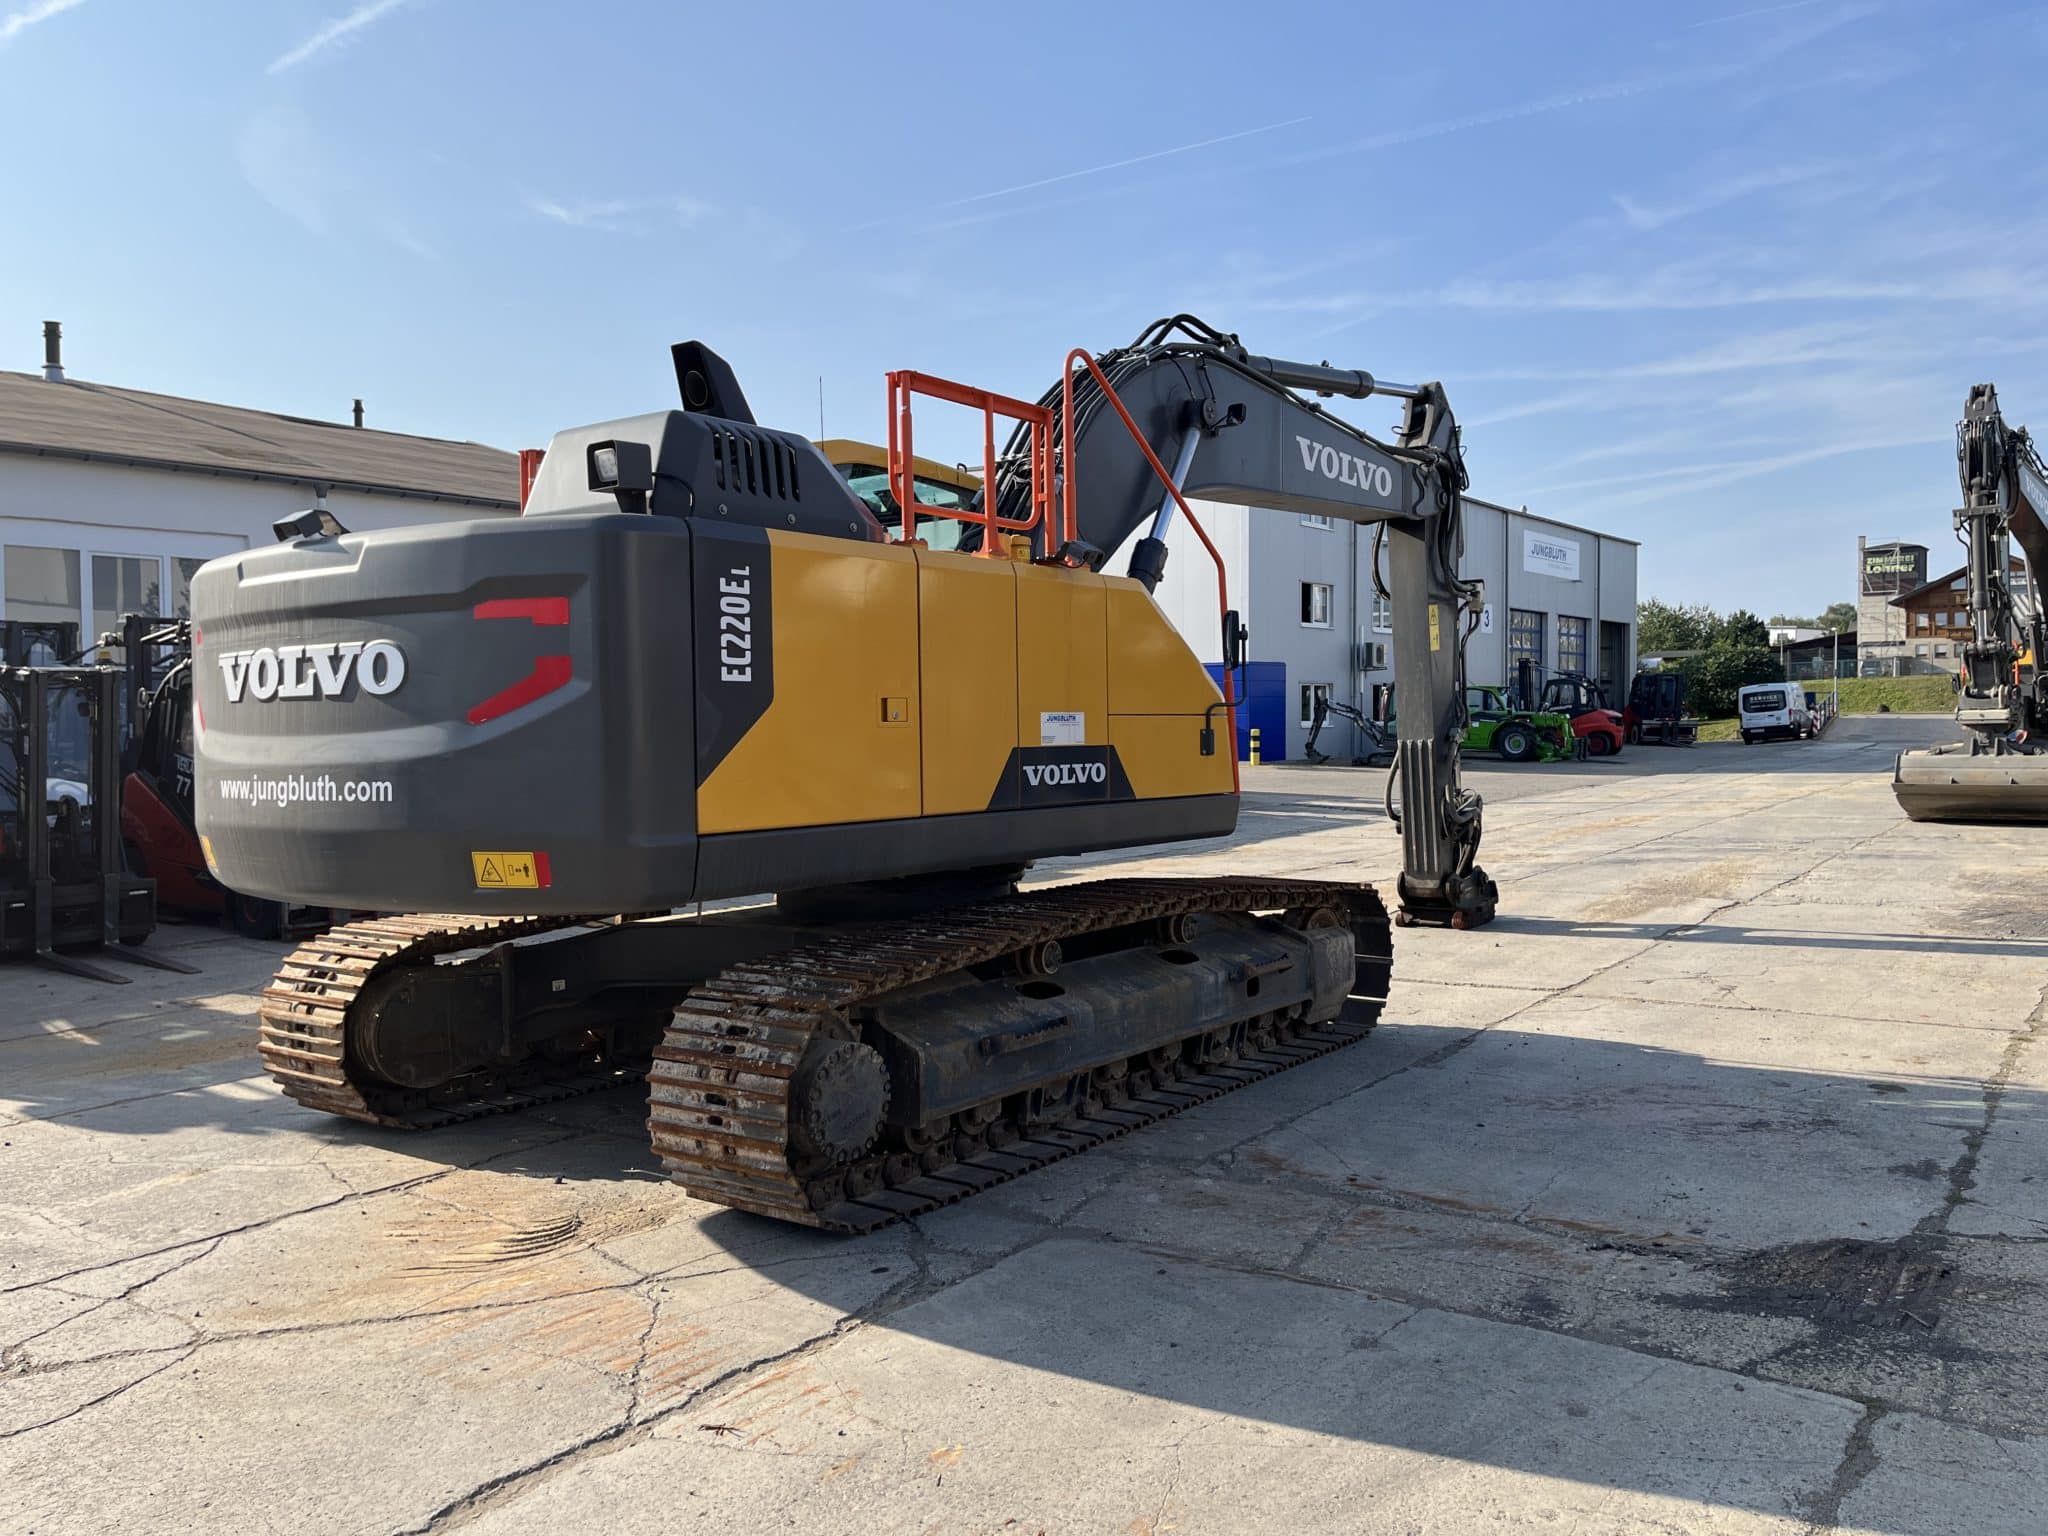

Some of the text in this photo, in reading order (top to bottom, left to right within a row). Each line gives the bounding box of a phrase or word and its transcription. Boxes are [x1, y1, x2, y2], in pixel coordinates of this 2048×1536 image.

[1296, 435, 1392, 497] VOLVO
[1530, 543, 1567, 561] JUNGBLUTH
[1484, 609, 1490, 627] 3
[218, 639, 406, 703] VOLVO
[1023, 762, 1106, 786] VOLVO
[220, 774, 393, 807] www.jungbluth.com
